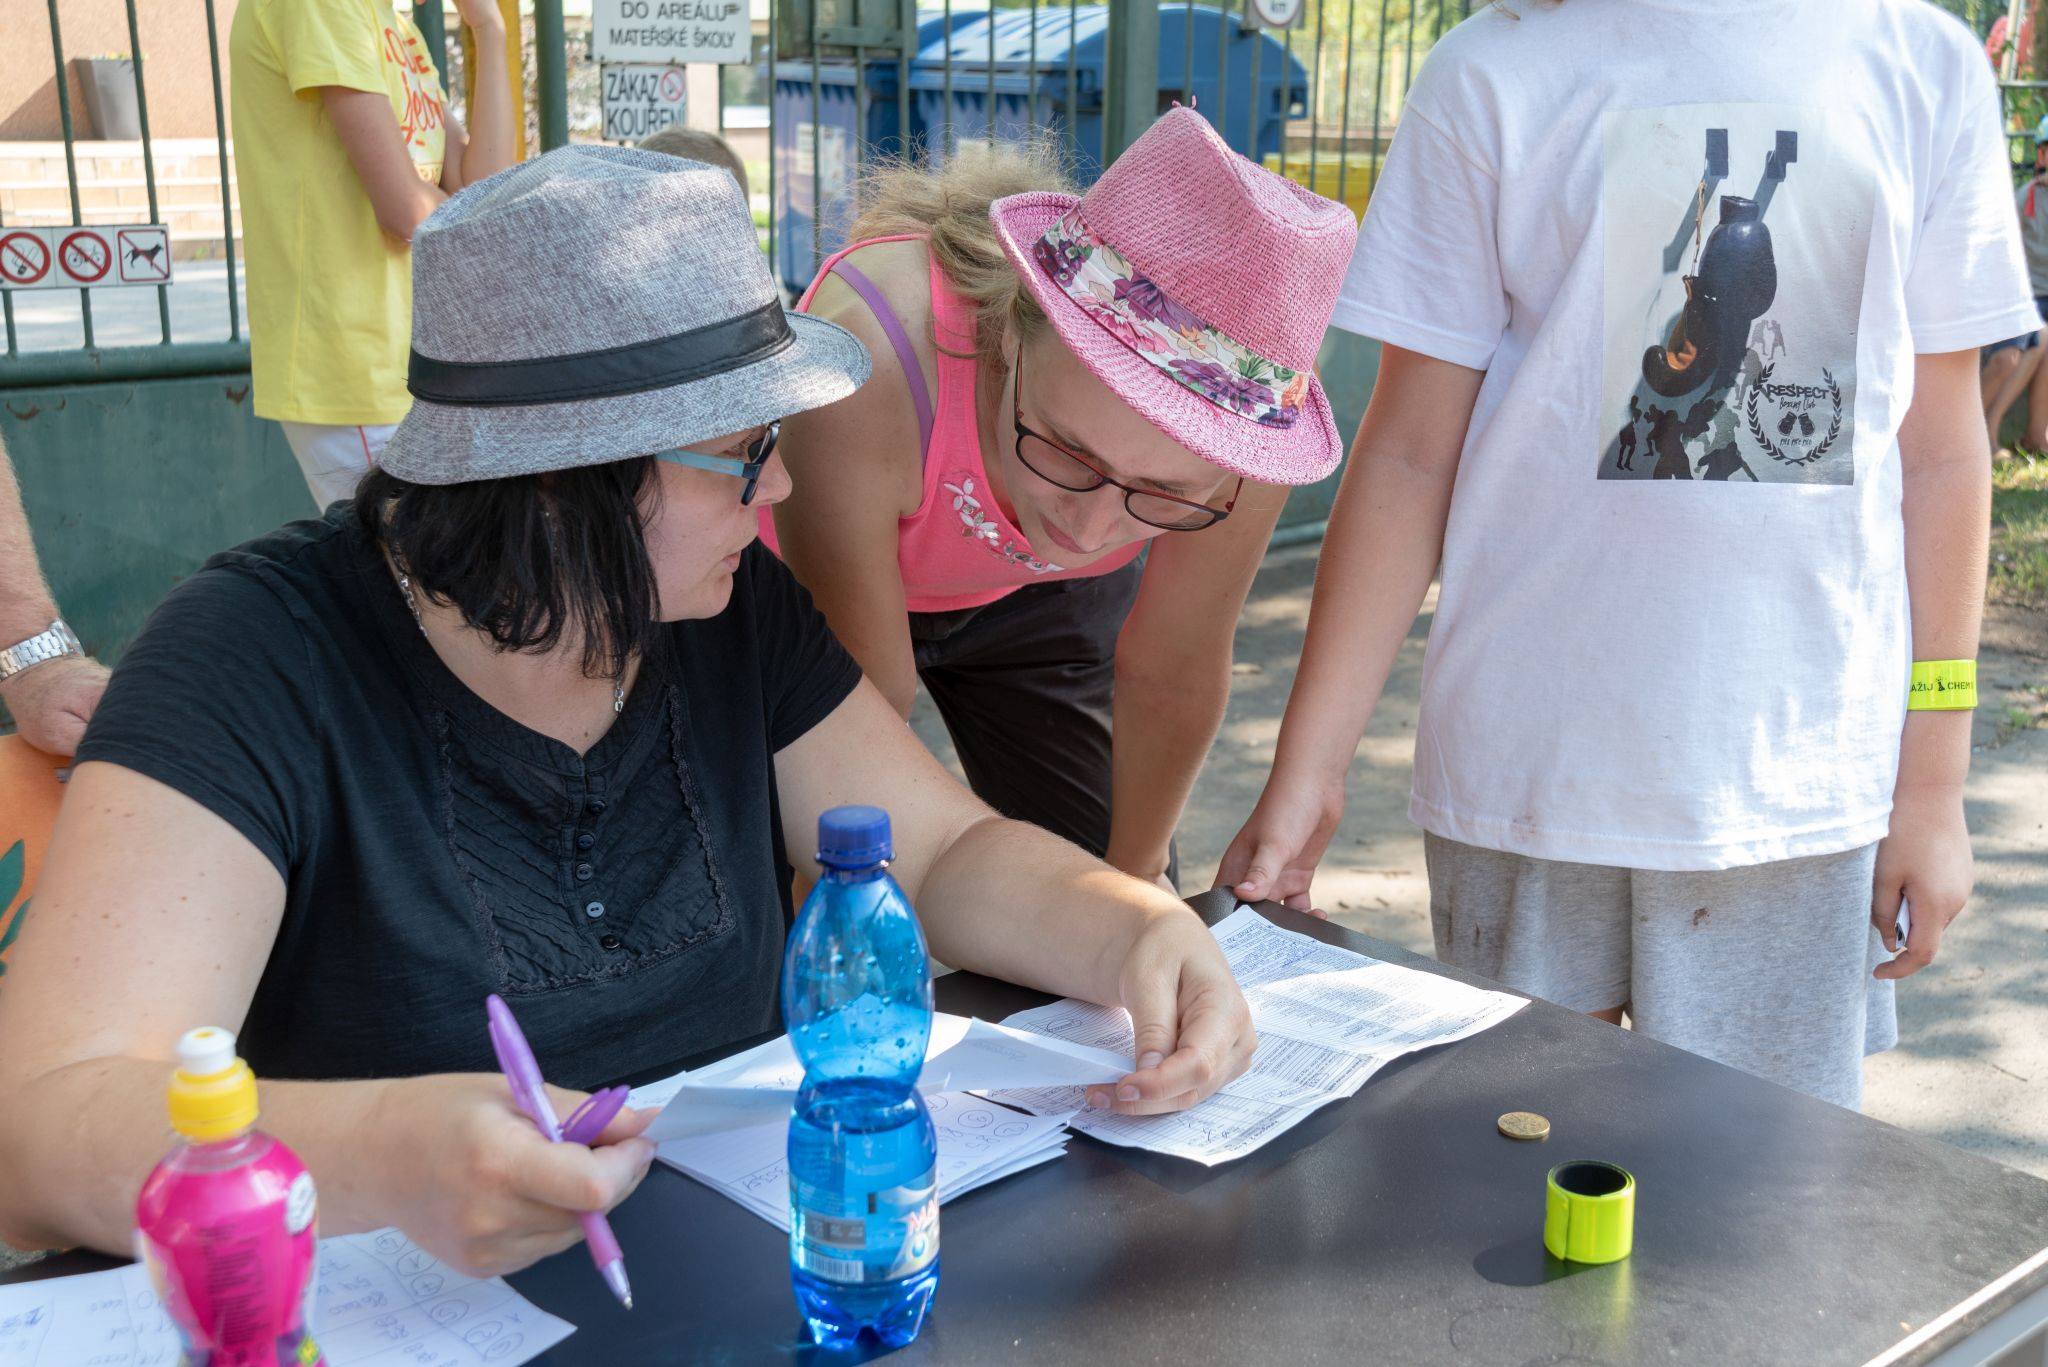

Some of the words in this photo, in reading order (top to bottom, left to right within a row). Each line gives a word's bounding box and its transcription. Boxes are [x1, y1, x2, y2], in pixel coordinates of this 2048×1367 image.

[621, 1, 649, 19] DO
[610, 26, 689, 47] MATEŘSKÉ
[693, 27, 736, 48] ŠKOLY
[607, 68, 659, 102] ZÁKAZ
[1766, 383, 1830, 399] RESPECT
